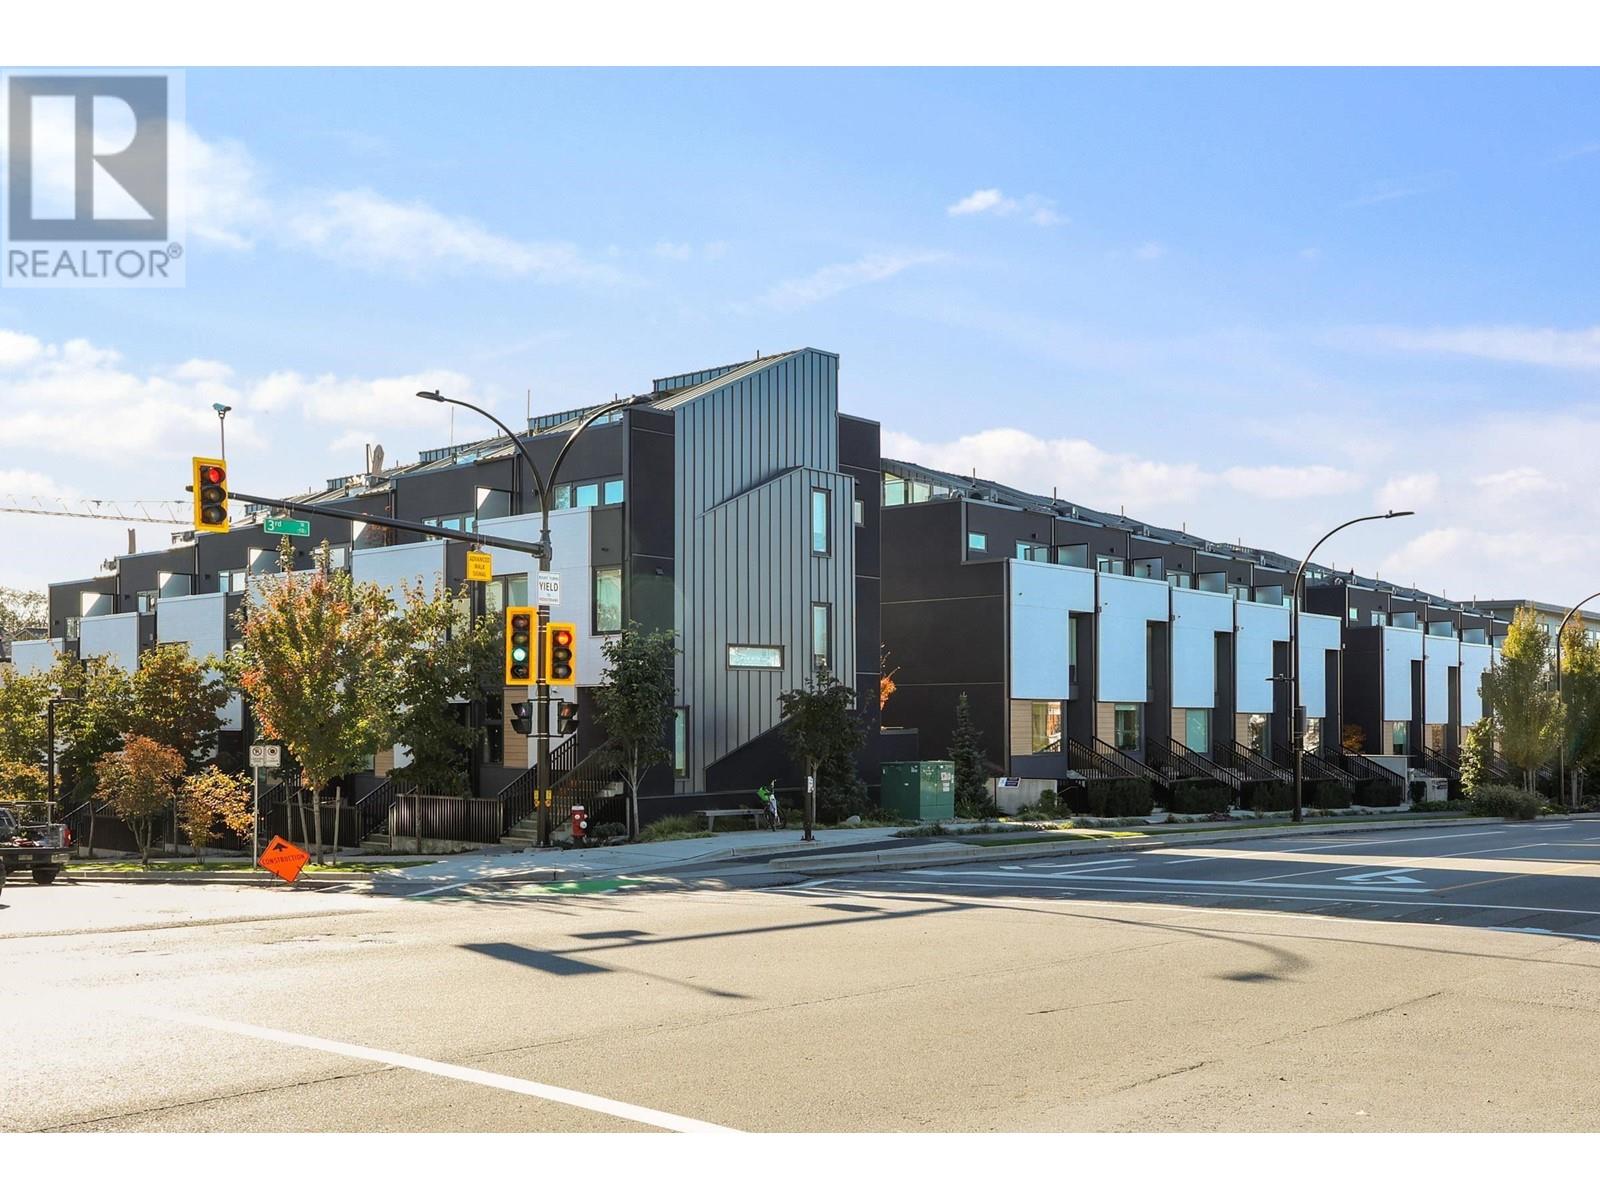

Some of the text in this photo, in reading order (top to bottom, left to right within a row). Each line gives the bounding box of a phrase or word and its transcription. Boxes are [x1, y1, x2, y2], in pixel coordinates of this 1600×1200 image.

[267, 520, 282, 530] 3rd
[539, 582, 559, 592] YIELD
[262, 854, 305, 865] CONSTRUCTION
